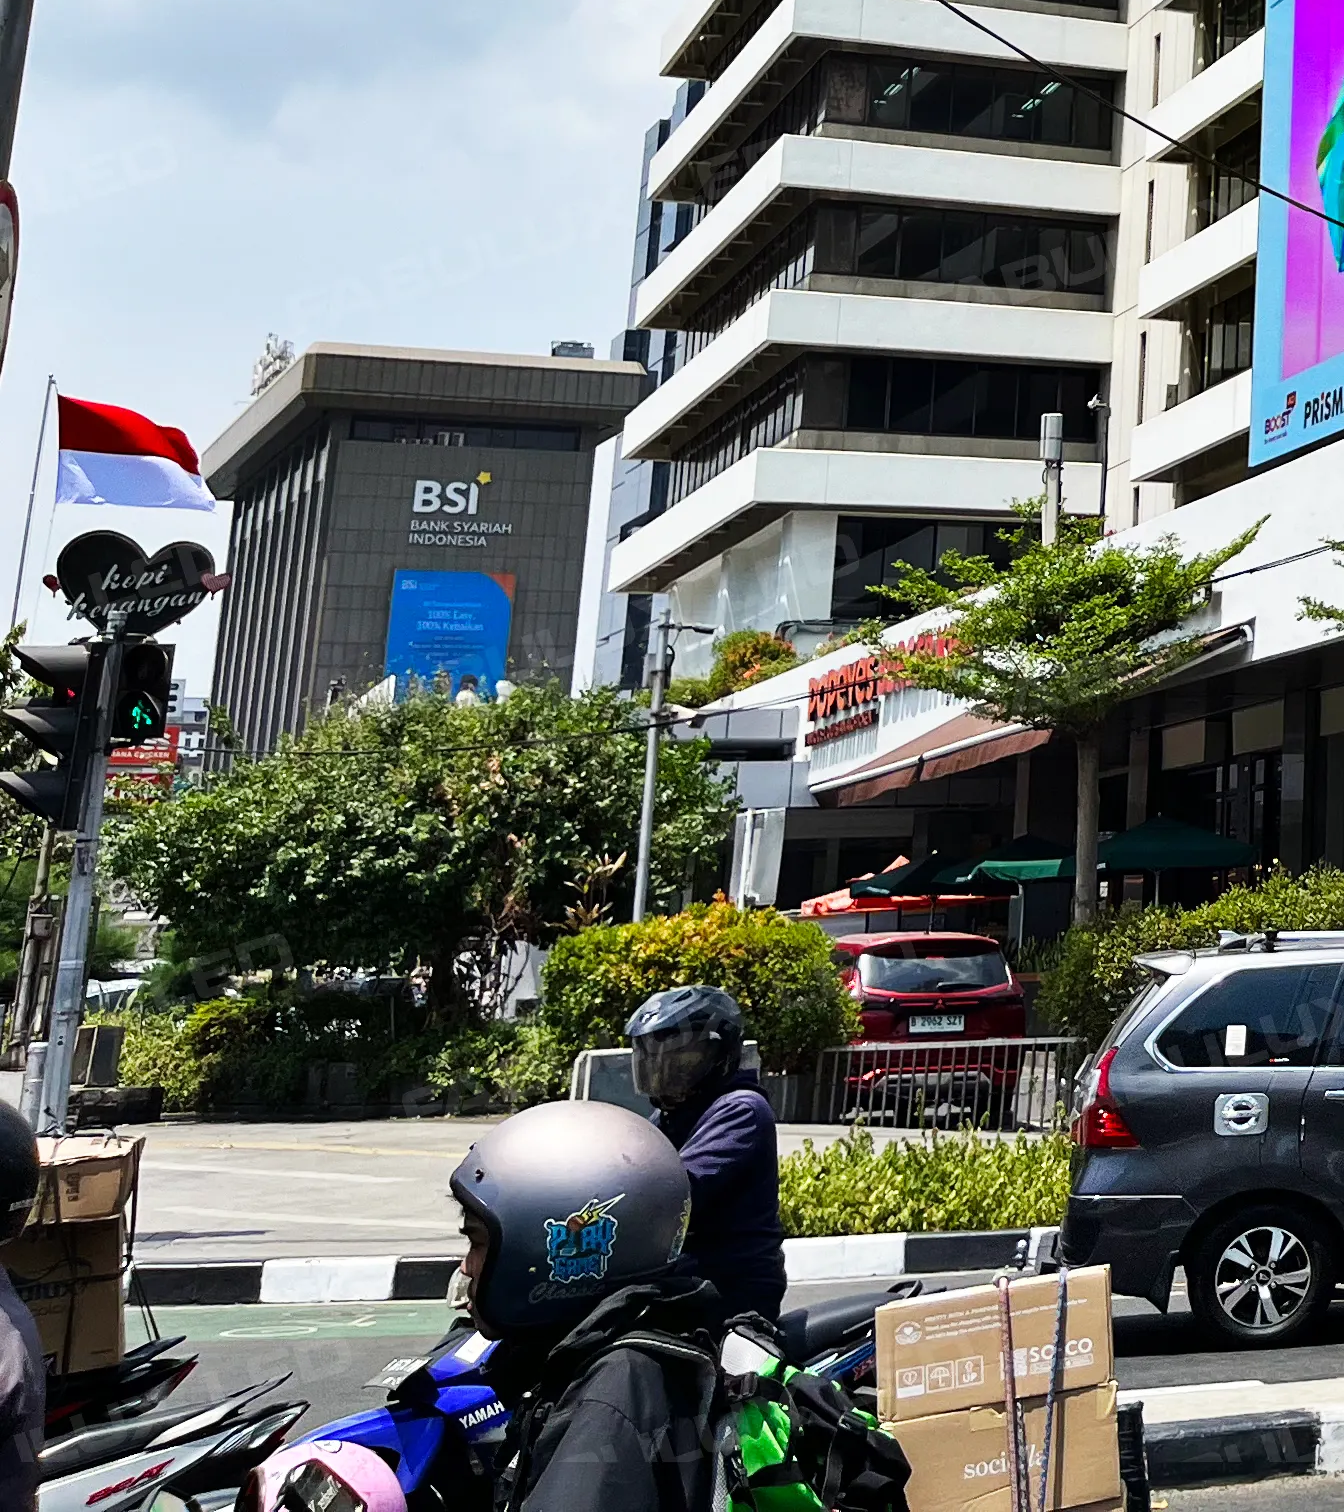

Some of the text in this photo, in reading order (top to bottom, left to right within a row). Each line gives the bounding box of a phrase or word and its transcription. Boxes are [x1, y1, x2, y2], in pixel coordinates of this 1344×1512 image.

[412, 479, 480, 516] BSI
[408, 533, 488, 548] INDONESIA
[410, 519, 513, 535] BANK SYARIAH
[101, 563, 169, 591] kopi
[962, 1372, 978, 1383] UP
[458, 1400, 506, 1429] YAMAH
[963, 1444, 1047, 1480] socila
